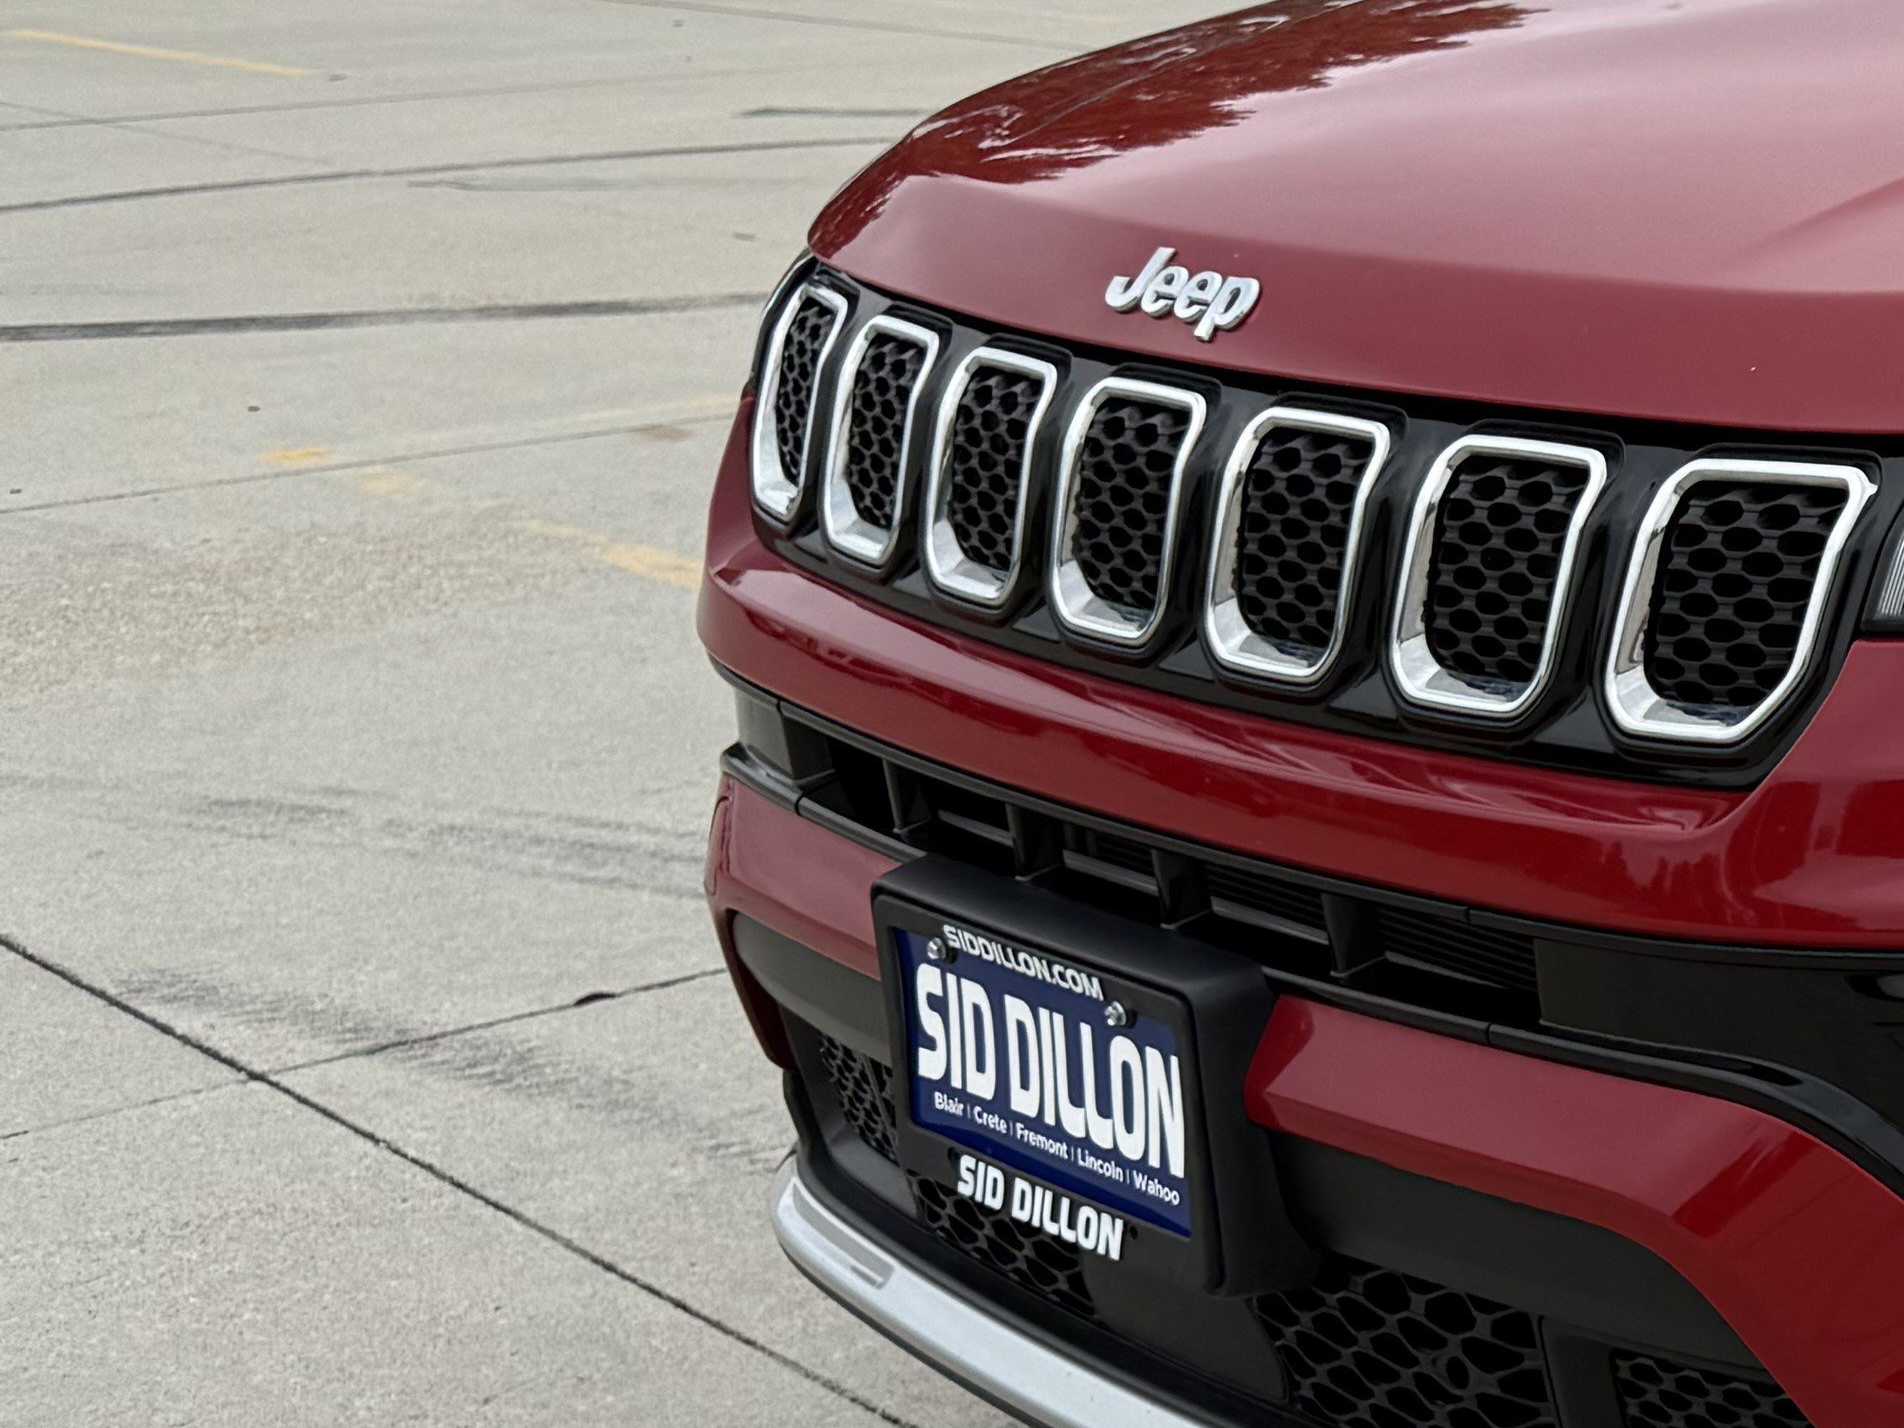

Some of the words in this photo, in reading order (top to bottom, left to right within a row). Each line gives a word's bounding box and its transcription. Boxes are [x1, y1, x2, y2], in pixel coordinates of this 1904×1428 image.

[1104, 246, 1260, 341] Jeep
[942, 924, 1104, 1002] SIDDILLON.COM
[916, 963, 996, 1101] SID
[1004, 994, 1186, 1179] DILLON
[934, 1091, 965, 1117] Blair
[973, 1105, 1008, 1135] Crete
[1016, 1122, 1069, 1160] Fremont
[1077, 1147, 1124, 1183] Lincoln
[1132, 1169, 1181, 1206] Wahoo
[957, 1154, 1005, 1211] SID
[1011, 1176, 1124, 1261] DILLON
